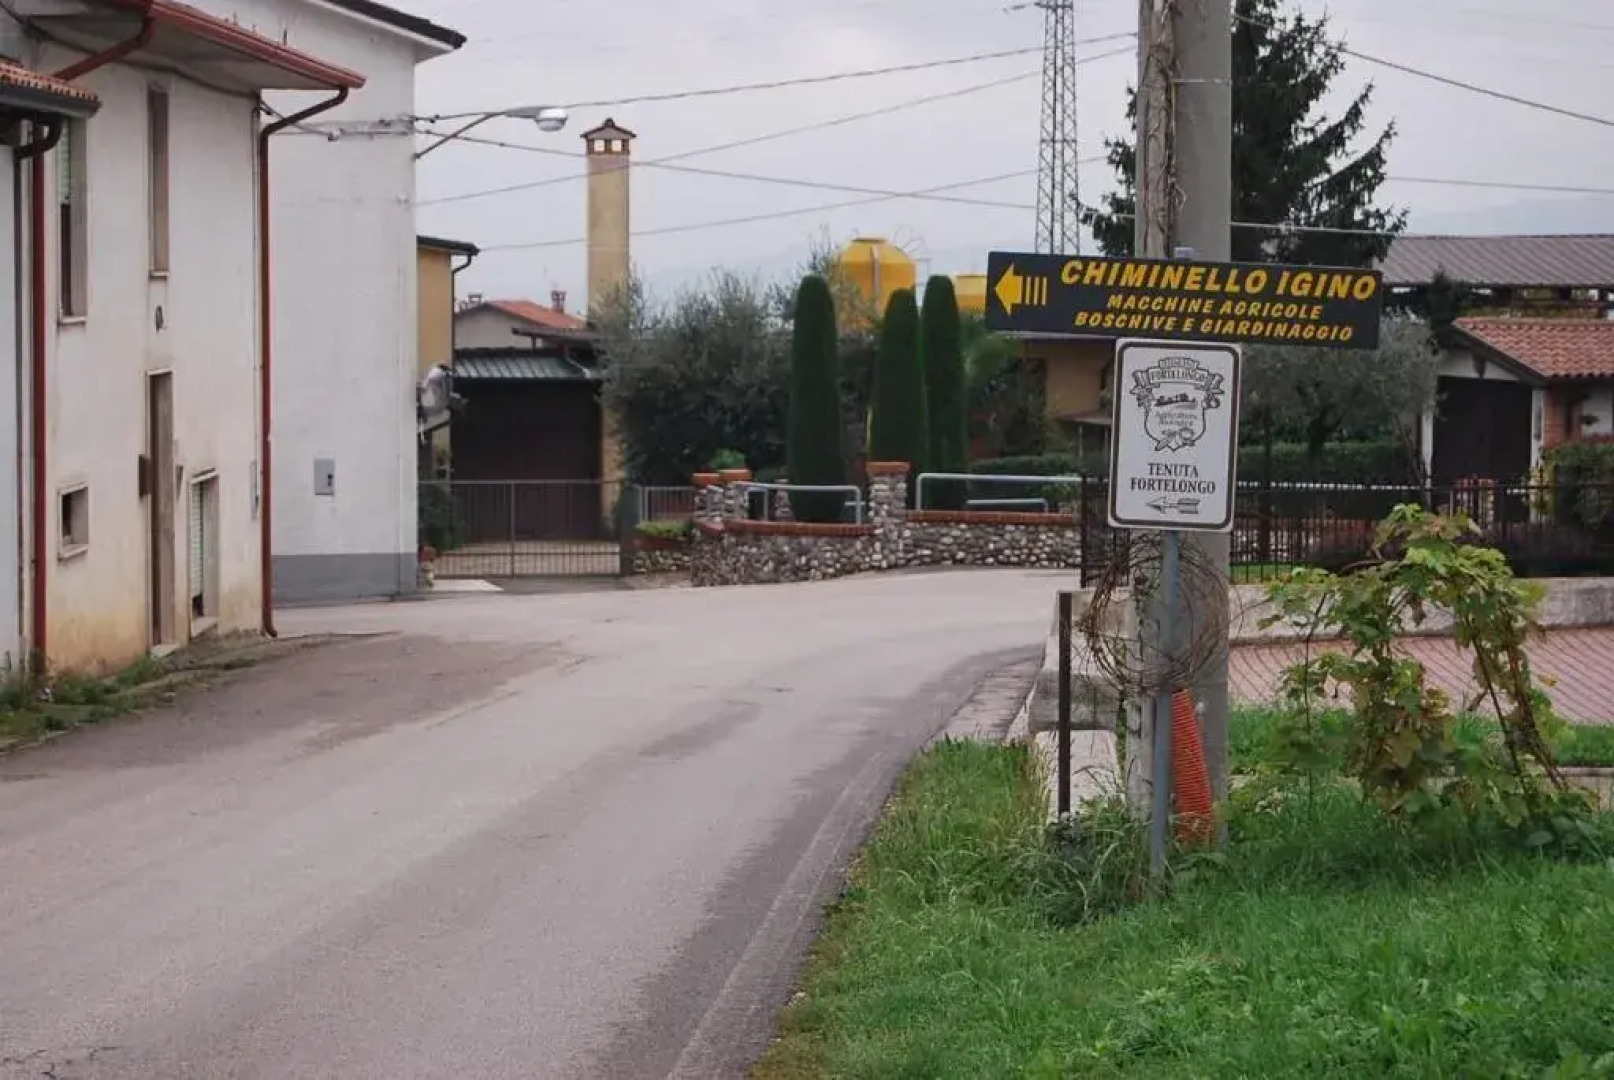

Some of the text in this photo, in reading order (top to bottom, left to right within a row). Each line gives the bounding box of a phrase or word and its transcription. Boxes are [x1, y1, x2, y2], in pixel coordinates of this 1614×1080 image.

[1061, 260, 1376, 300] CHIMINELLO IGINO
[1107, 295, 1323, 319] MACCHINE AGRICOLE
[1183, 320, 1192, 332] E
[1201, 319, 1353, 341] GIARDINAGGIO
[1148, 462, 1199, 478] TENUTA
[1130, 478, 1216, 494] FORTELONGO
